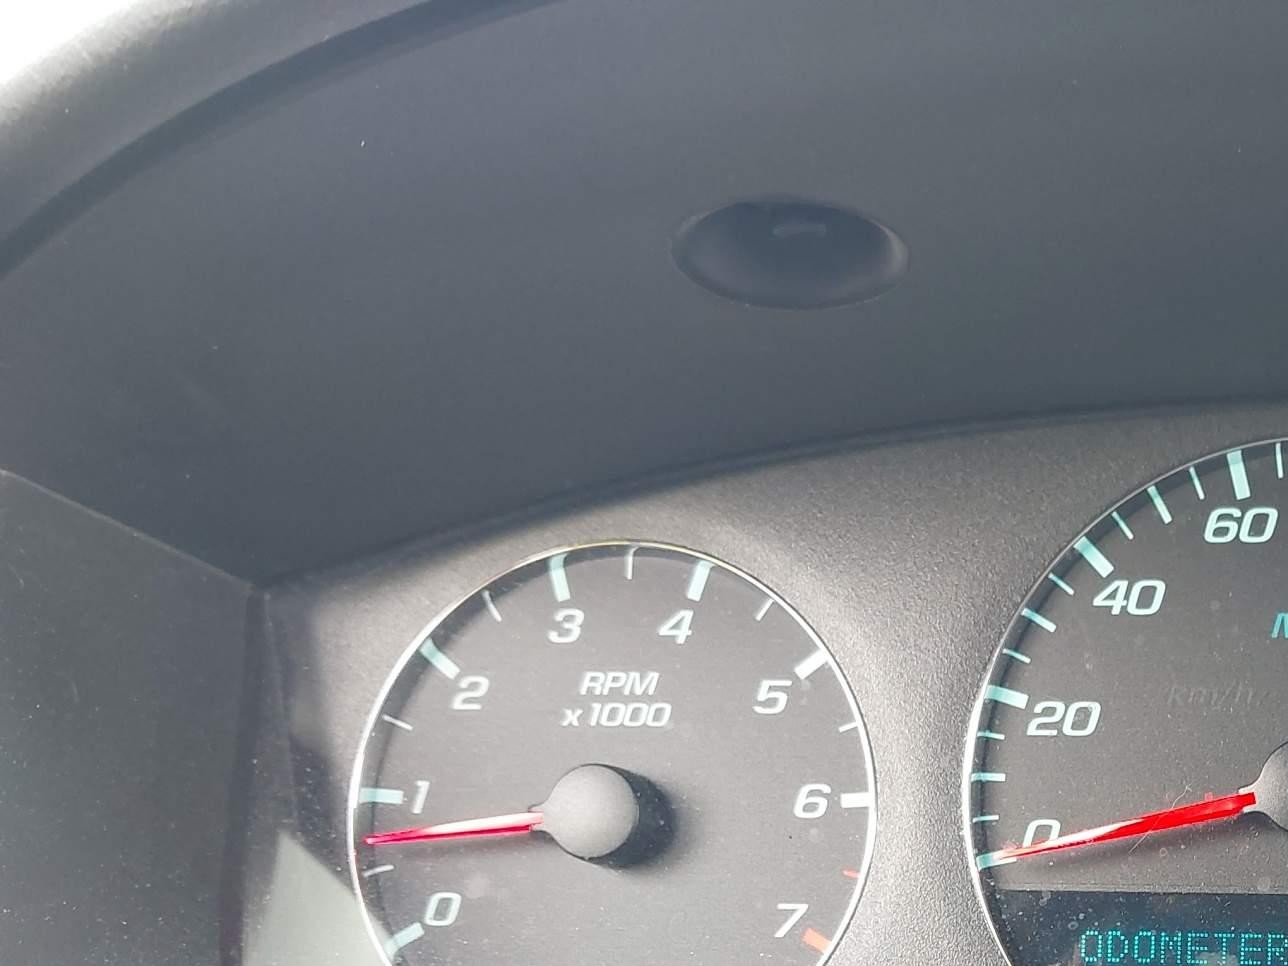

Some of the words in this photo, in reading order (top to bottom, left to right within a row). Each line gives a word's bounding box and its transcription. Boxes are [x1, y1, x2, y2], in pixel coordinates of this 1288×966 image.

[1204, 507, 1278, 544] 60
[1093, 579, 1166, 616] 40
[549, 609, 584, 644] 3
[657, 610, 693, 643] 4
[451, 675, 490, 710] 2
[580, 671, 659, 696] RPM
[753, 679, 792, 715] 5
[1027, 701, 1101, 736] 20
[411, 780, 430, 813] 1
[793, 784, 832, 819] 6
[1021, 820, 1061, 850] 0
[425, 892, 461, 927] 0
[775, 903, 808, 938] 7
[1079, 930, 1288, 966] ODOMETER
